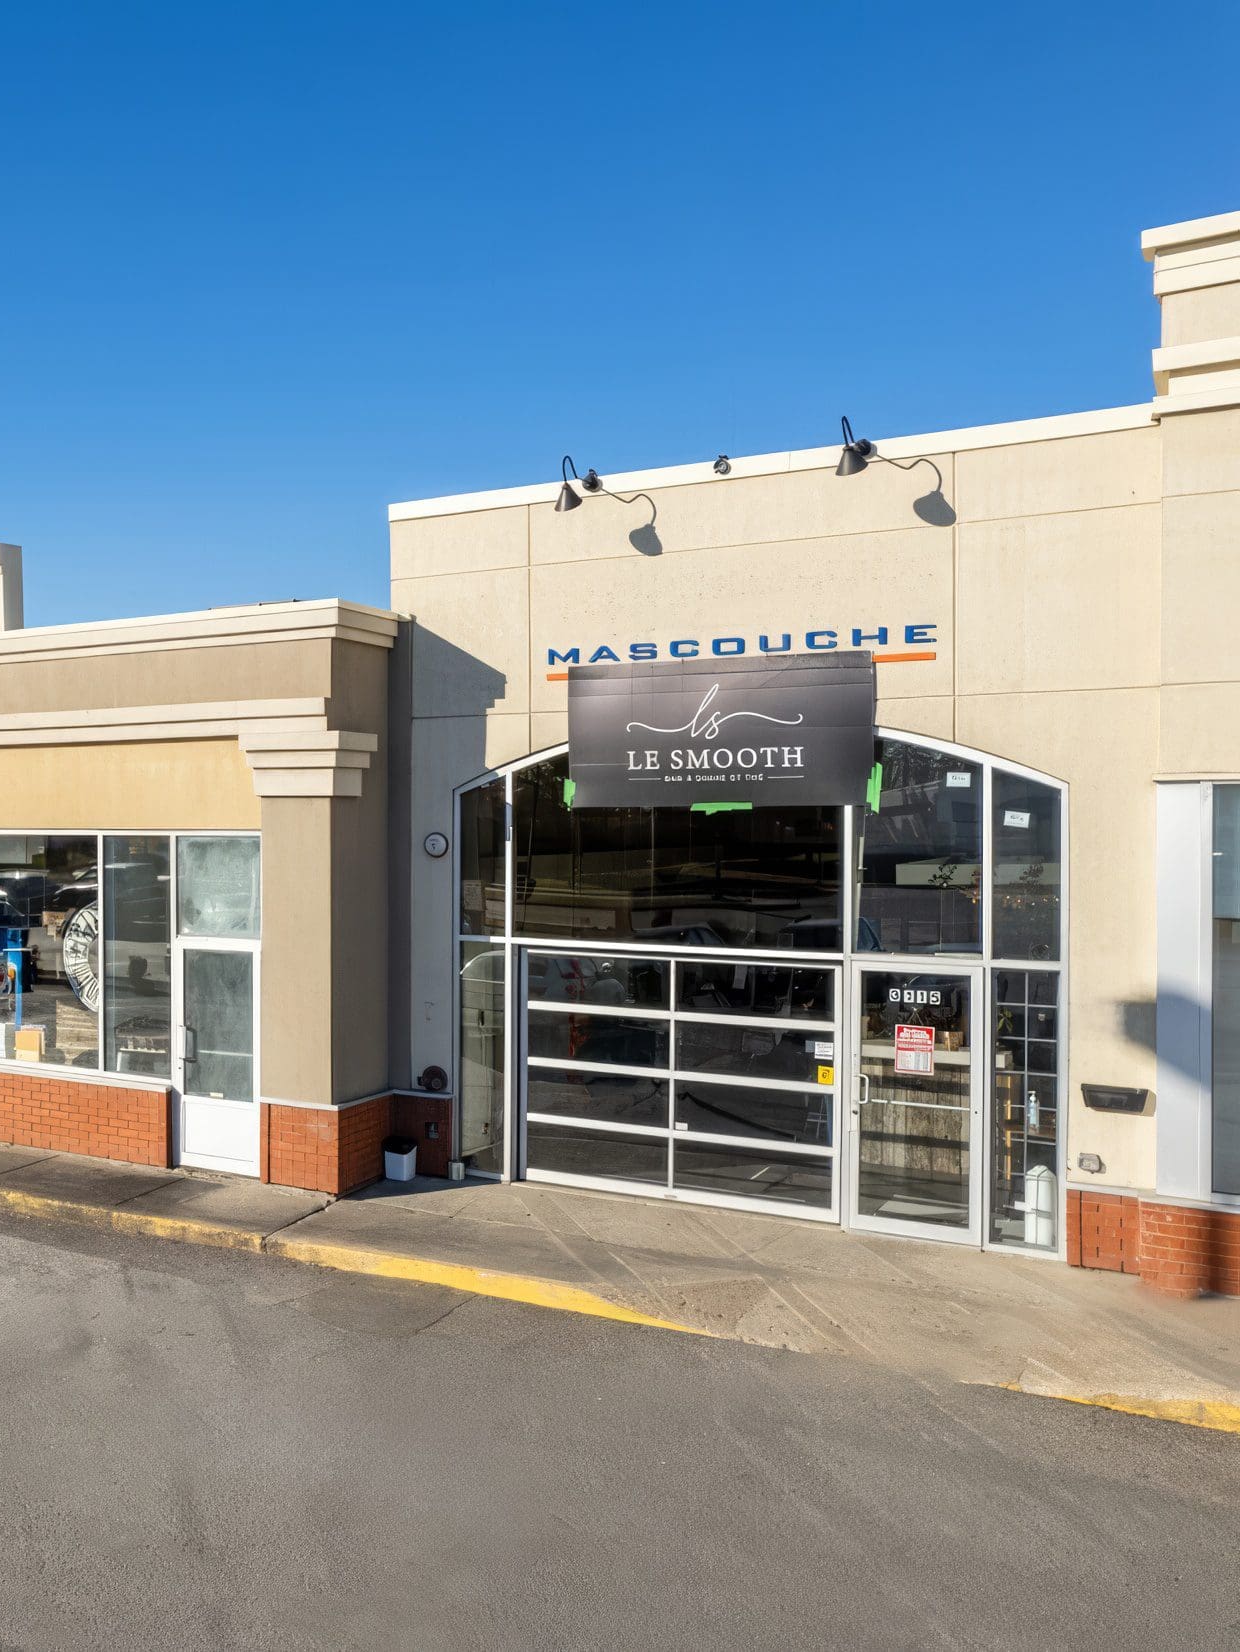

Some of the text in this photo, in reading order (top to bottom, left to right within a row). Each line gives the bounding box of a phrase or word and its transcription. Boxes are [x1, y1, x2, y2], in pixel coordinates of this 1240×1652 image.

[547, 624, 938, 666] MASCOUCHE
[627, 746, 804, 770] LE SMOOTH
